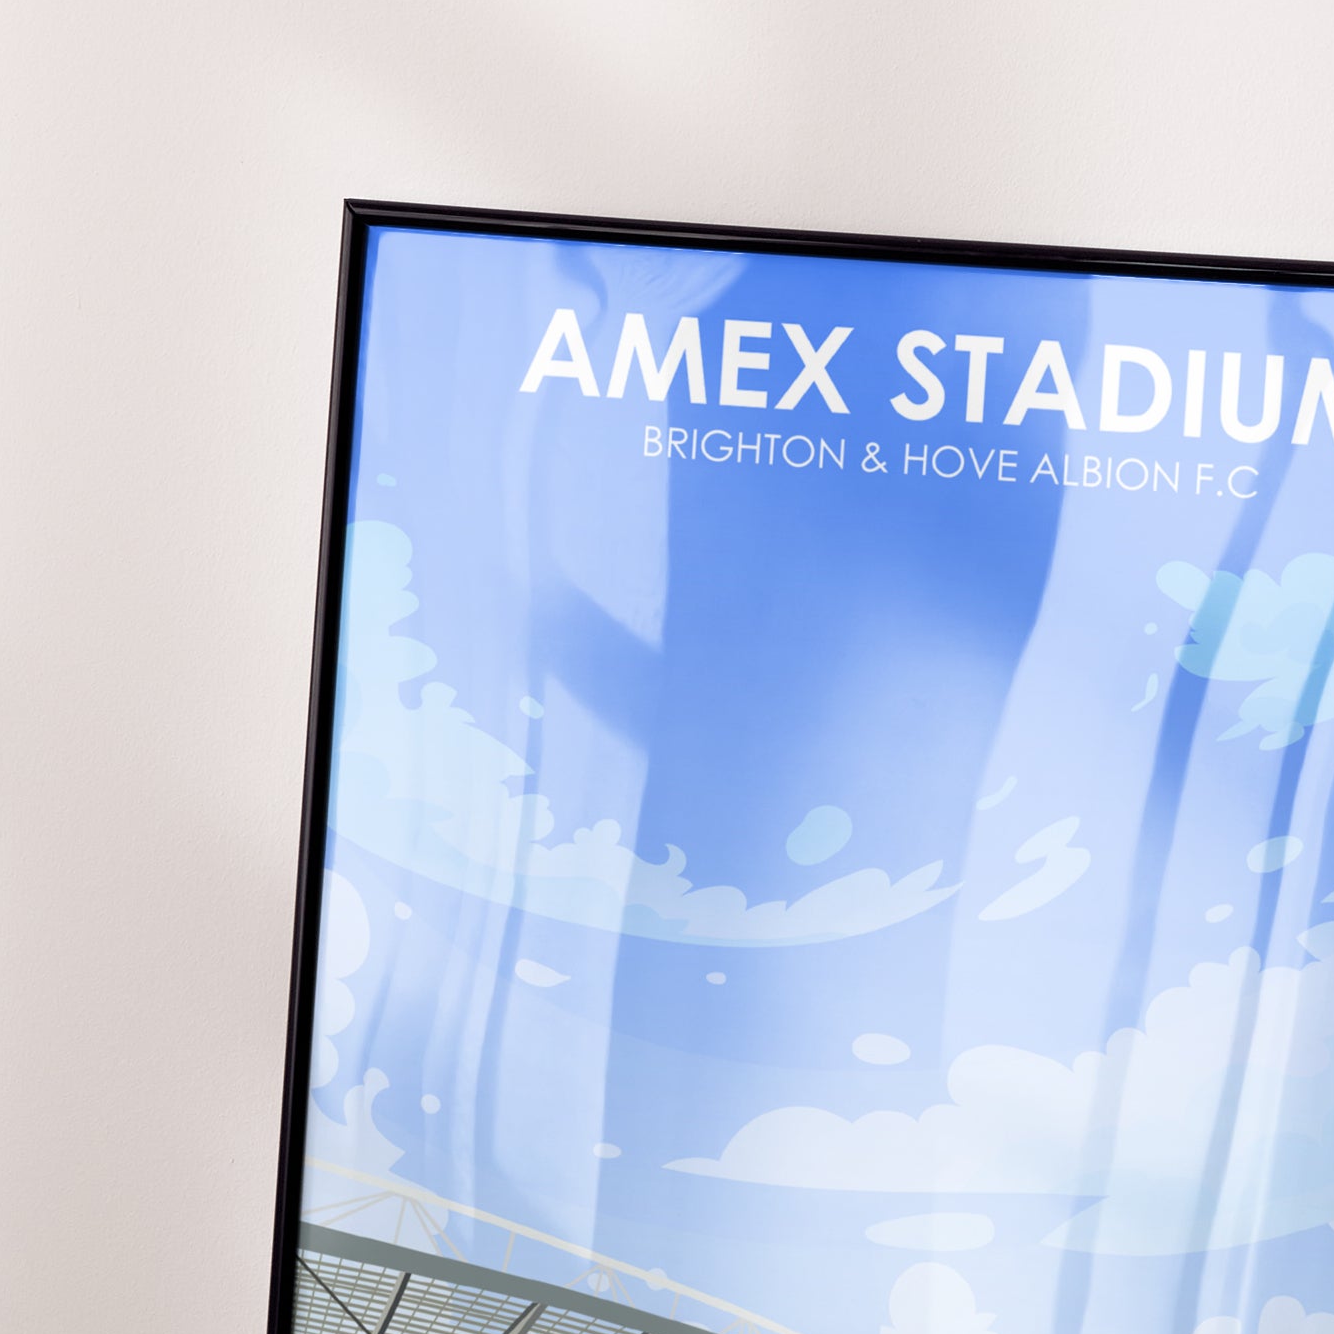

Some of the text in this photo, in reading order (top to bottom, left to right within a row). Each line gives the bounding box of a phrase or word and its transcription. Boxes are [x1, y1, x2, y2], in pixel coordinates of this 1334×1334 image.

[519, 308, 853, 414] AMEX
[643, 425, 1260, 499] BRIGHTON & HOVE ALBION F.C
